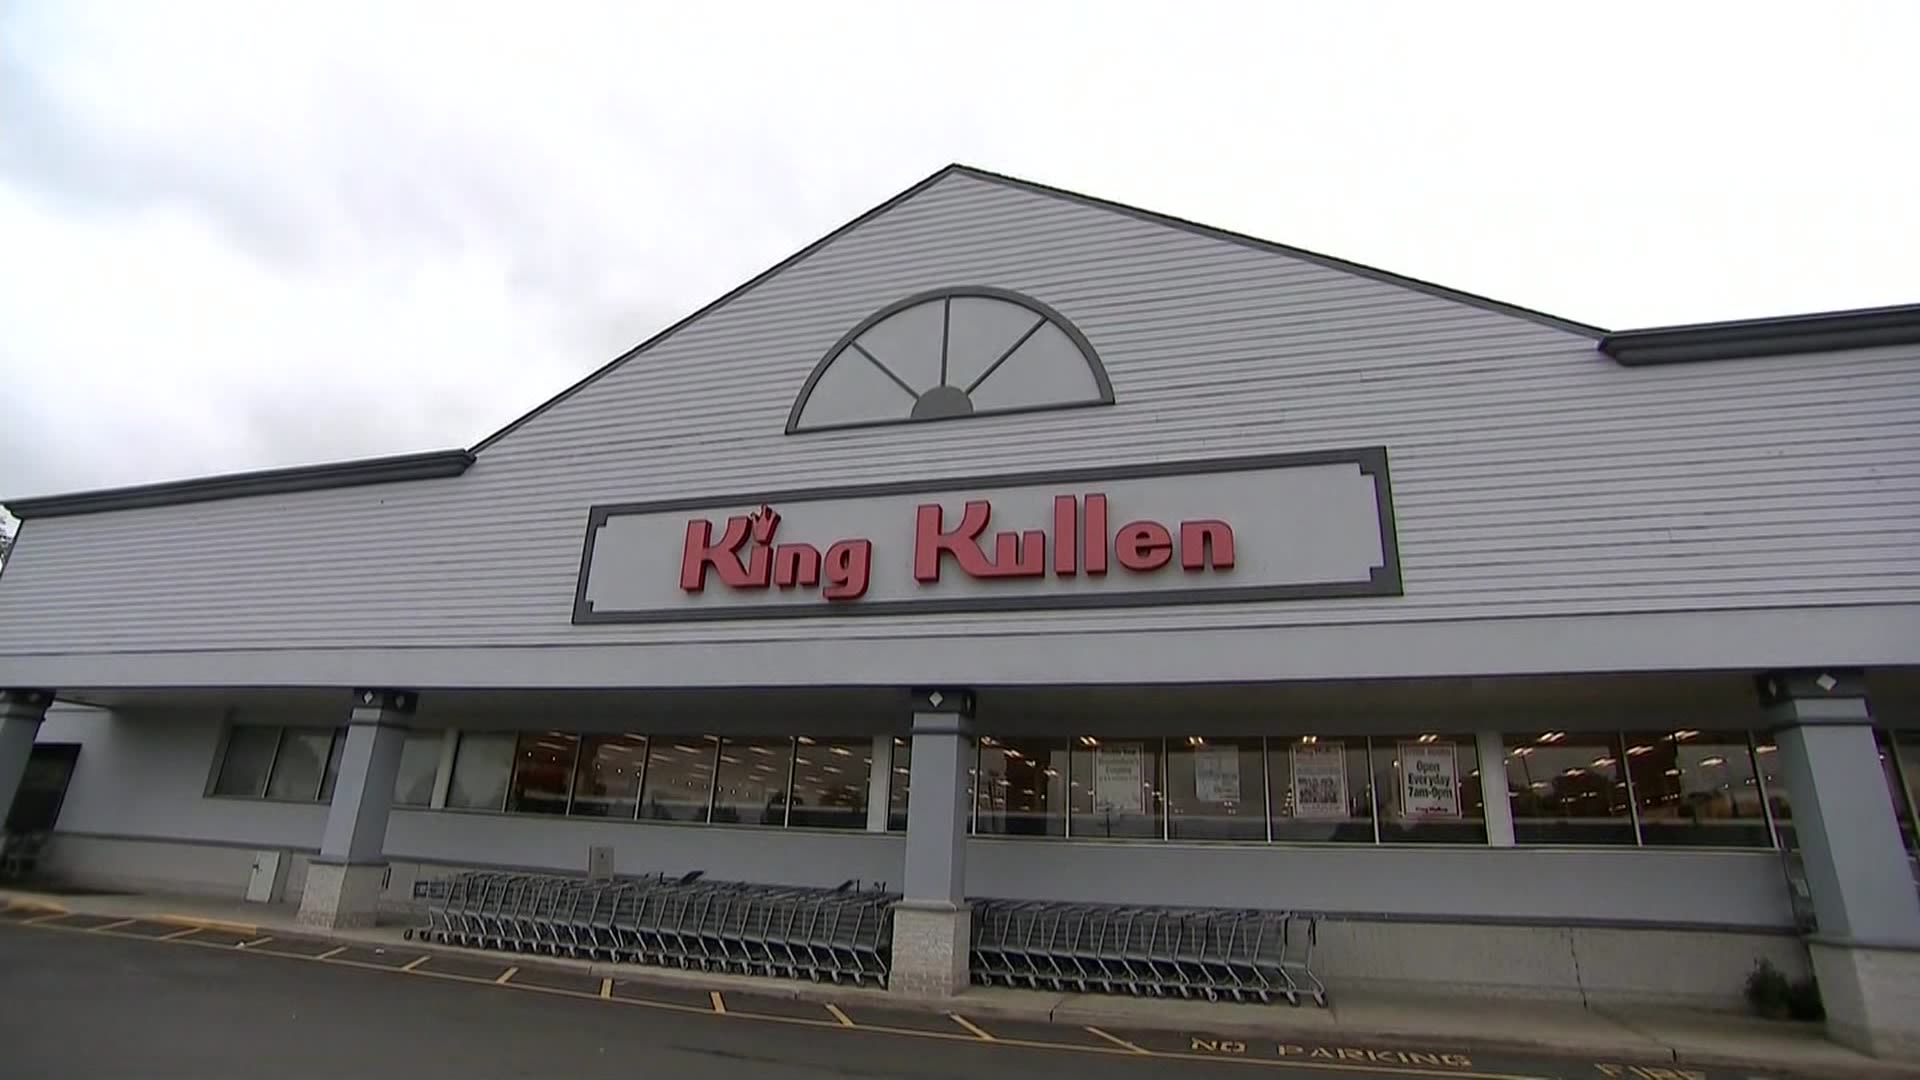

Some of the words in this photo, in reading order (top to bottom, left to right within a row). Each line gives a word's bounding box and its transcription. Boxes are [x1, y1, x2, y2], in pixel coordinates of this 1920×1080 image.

[680, 503, 871, 600] King
[914, 493, 1235, 584] Kullen
[1416, 760, 1440, 774] Open
[1408, 772, 1450, 787] Everyday
[1191, 1037, 1246, 1053] NO
[1278, 1044, 1473, 1067] PARKING
